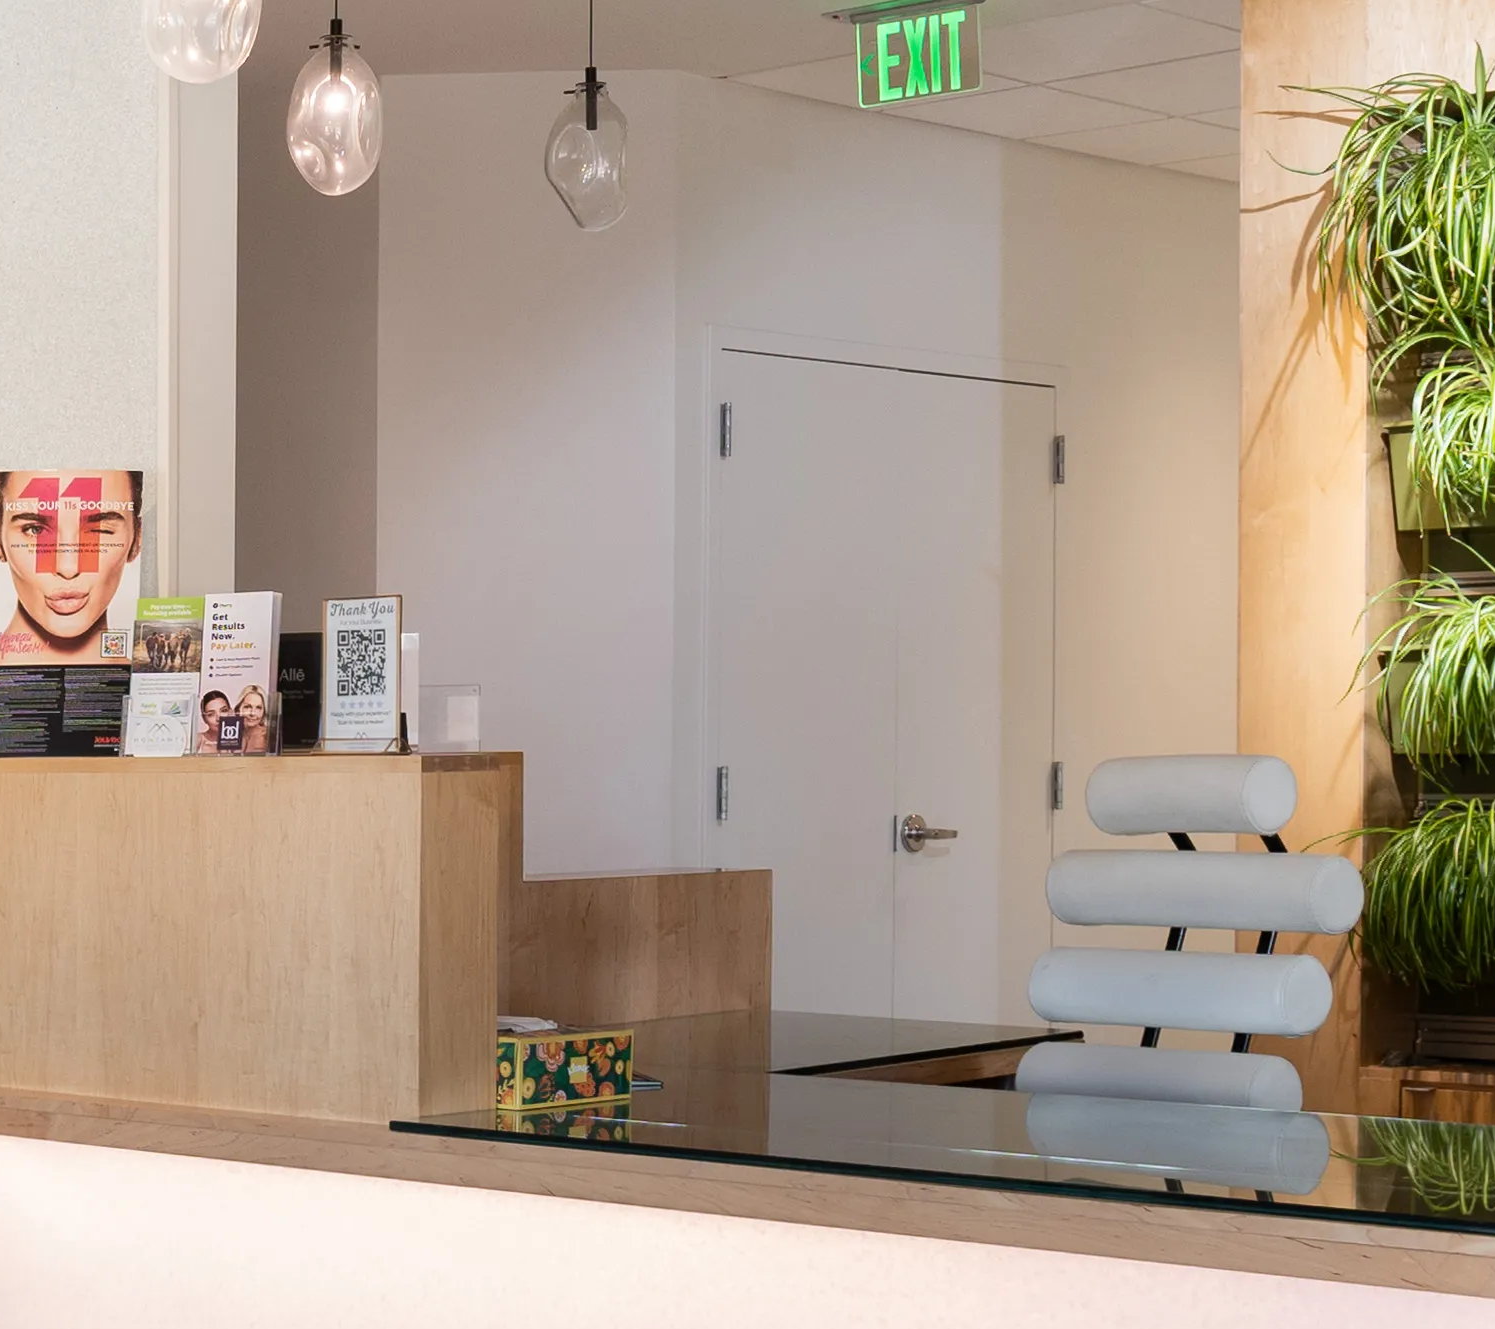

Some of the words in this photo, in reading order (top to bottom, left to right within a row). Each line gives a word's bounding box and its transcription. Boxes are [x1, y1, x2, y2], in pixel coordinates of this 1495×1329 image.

[877, 10, 965, 101] EXIT
[6, 502, 29, 511] KISS
[31, 501, 60, 510] YOUR
[64, 502, 77, 510] 11s
[80, 501, 134, 511] GOODBYE
[18, 477, 102, 574] 11
[330, 602, 367, 617] Thank
[368, 601, 395, 619] You
[212, 613, 228, 621] Get
[212, 622, 245, 631] Results
[211, 633, 235, 641] Now.
[210, 642, 227, 652] Pay
[279, 668, 305, 682] Allē
